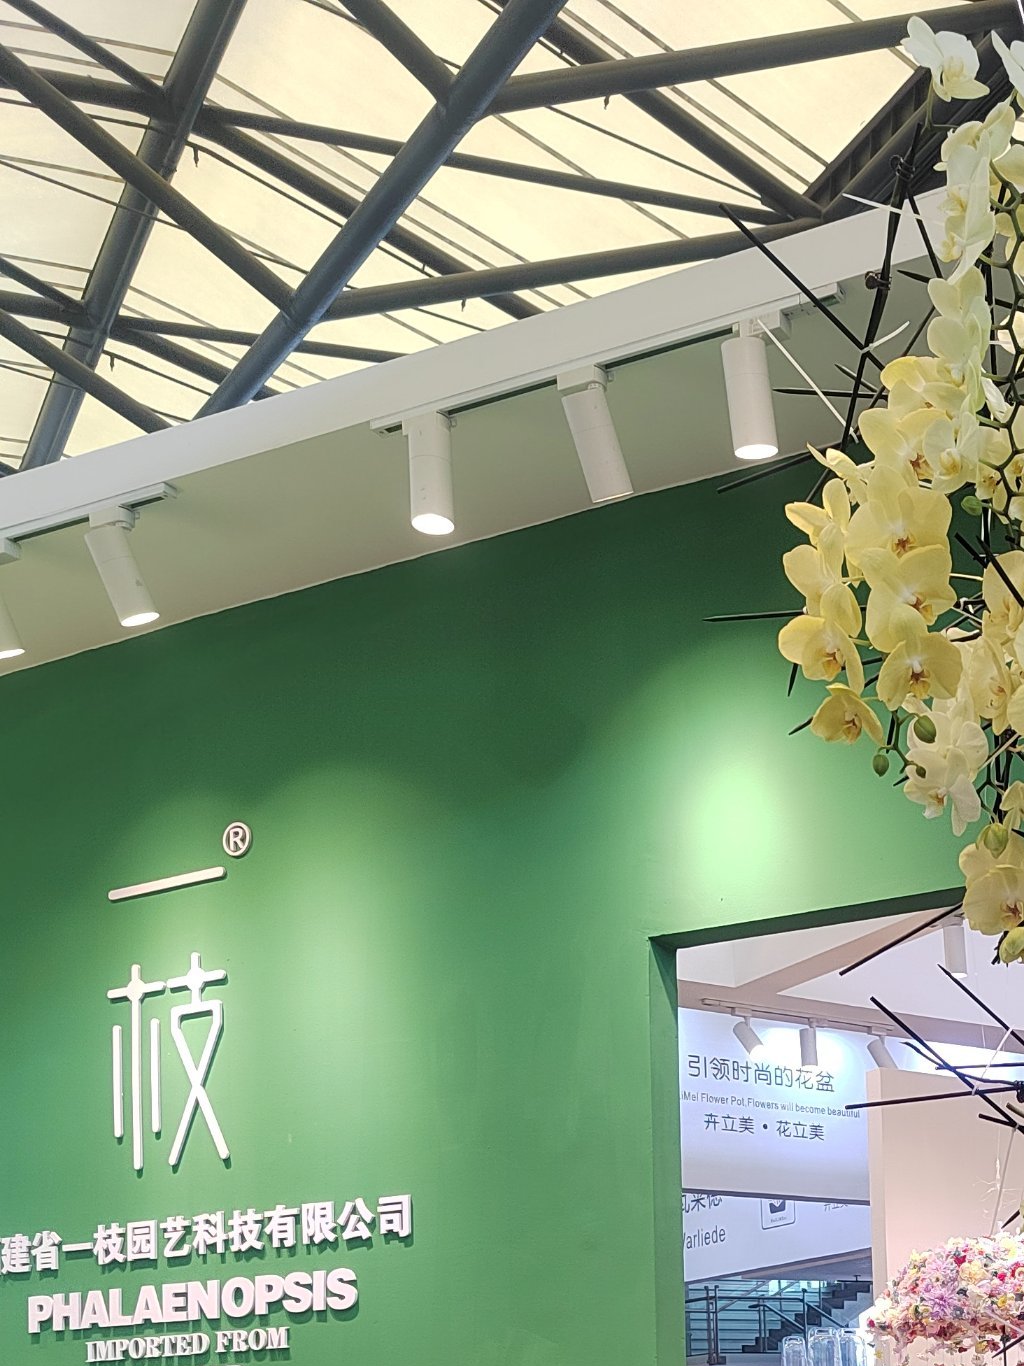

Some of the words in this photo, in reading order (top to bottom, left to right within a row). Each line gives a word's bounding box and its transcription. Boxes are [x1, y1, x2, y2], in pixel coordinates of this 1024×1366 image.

[687, 1054, 835, 1093] 引领时尚的花盆
[701, 1093, 728, 1105] Flower
[780, 1102, 794, 1112] will
[795, 1103, 825, 1115] become
[0, 1194, 411, 1276] 建省一枝园艺科技有限公司
[28, 1267, 358, 1334] PHALAENOPSIS
[85, 1331, 210, 1363] IMPORTED
[215, 1326, 290, 1354] FROM
